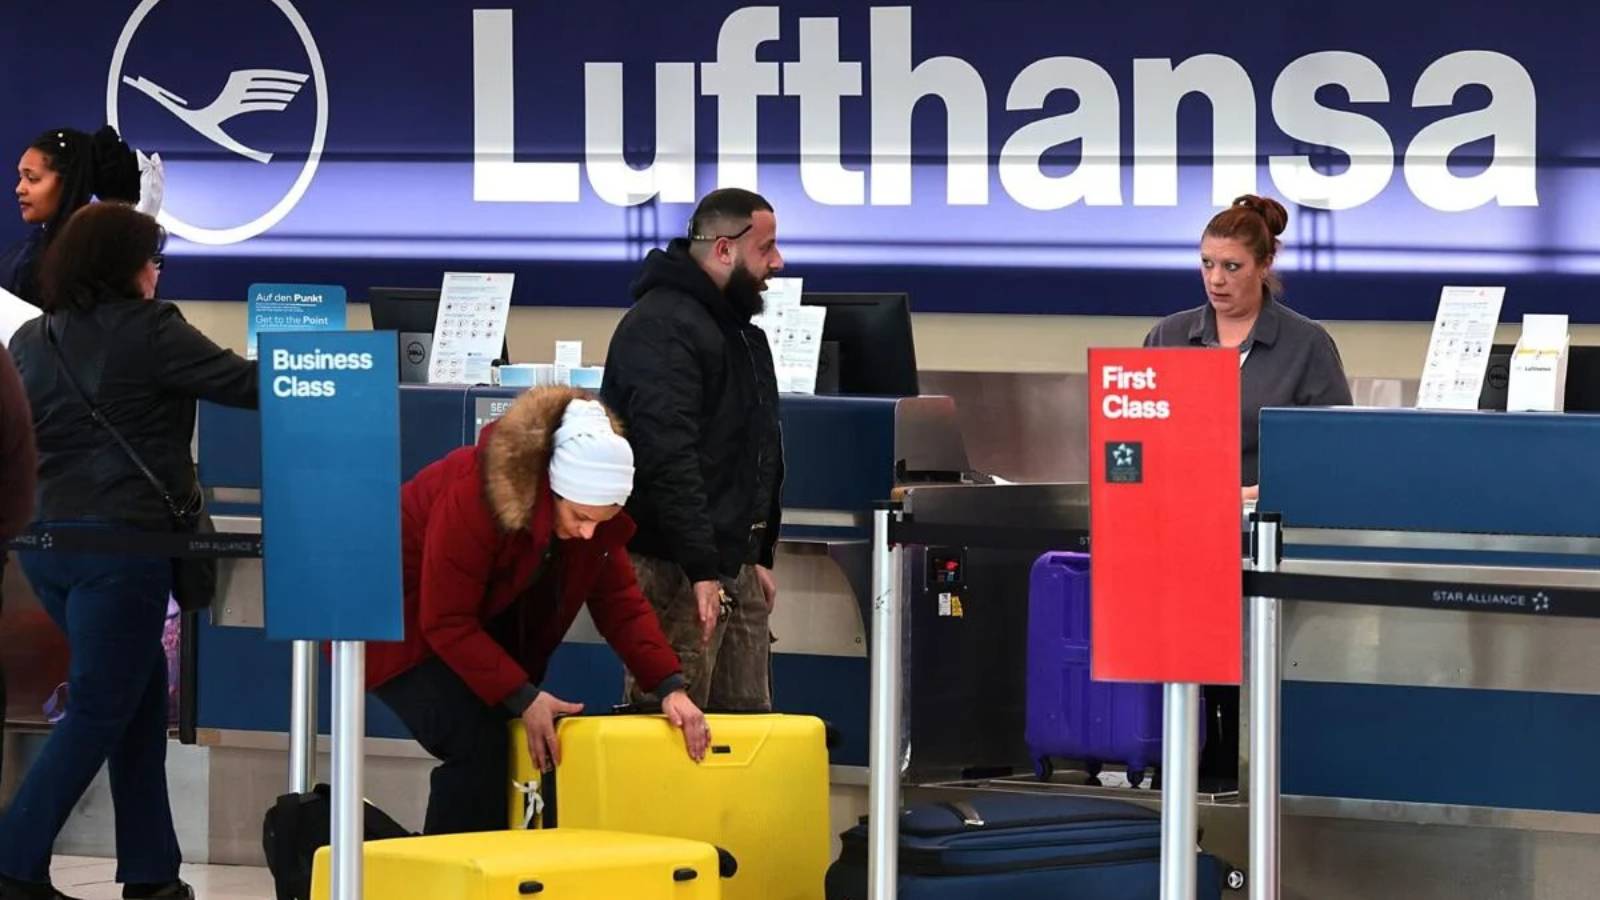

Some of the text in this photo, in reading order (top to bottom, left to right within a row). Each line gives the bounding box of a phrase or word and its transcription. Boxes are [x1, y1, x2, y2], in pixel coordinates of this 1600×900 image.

[473, 6, 1540, 212] Lufthansa
[256, 293, 323, 303] Auf den Punkt
[256, 315, 328, 325] Get to the Point
[272, 349, 373, 370] Business
[273, 376, 336, 397] Class
[1102, 365, 1157, 389] First
[490, 402, 512, 413] SEC
[1102, 395, 1170, 419] Class
[1433, 591, 1525, 606] STAR ALLIANCE
